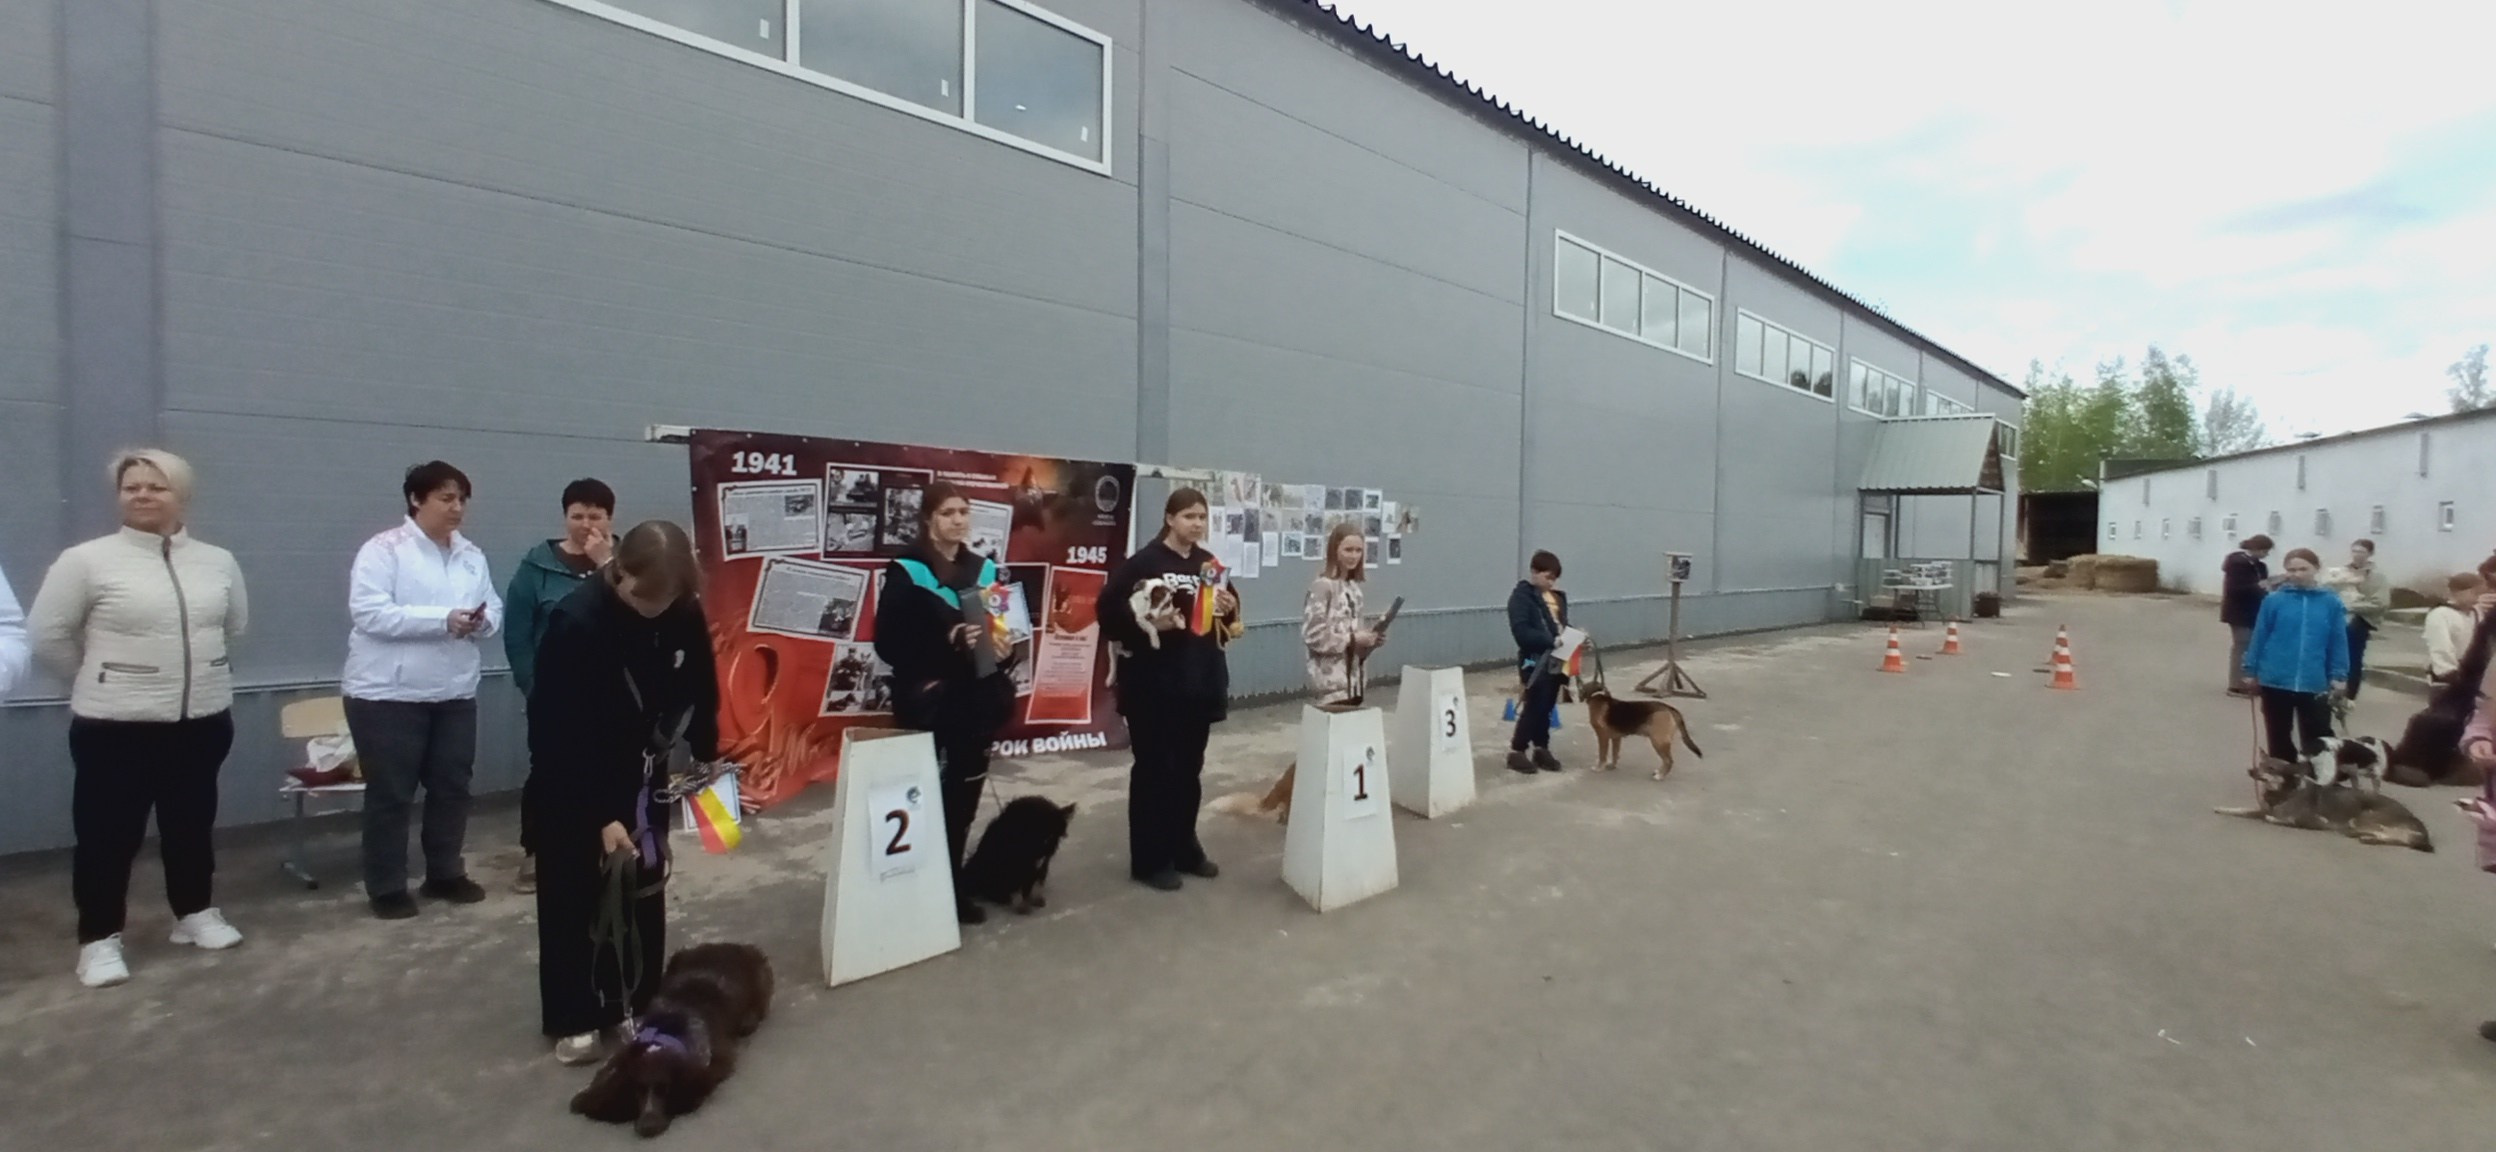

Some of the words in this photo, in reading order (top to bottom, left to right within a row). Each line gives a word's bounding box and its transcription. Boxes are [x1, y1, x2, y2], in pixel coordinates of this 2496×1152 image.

[731, 451, 798, 476] 1941
[1066, 546, 1108, 564] 1945
[1445, 708, 1457, 738] 3
[986, 740, 1029, 756] РОК
[1032, 730, 1108, 753] ВОЙНЫ
[1353, 763, 1369, 802] 1
[885, 808, 912, 856] 2
